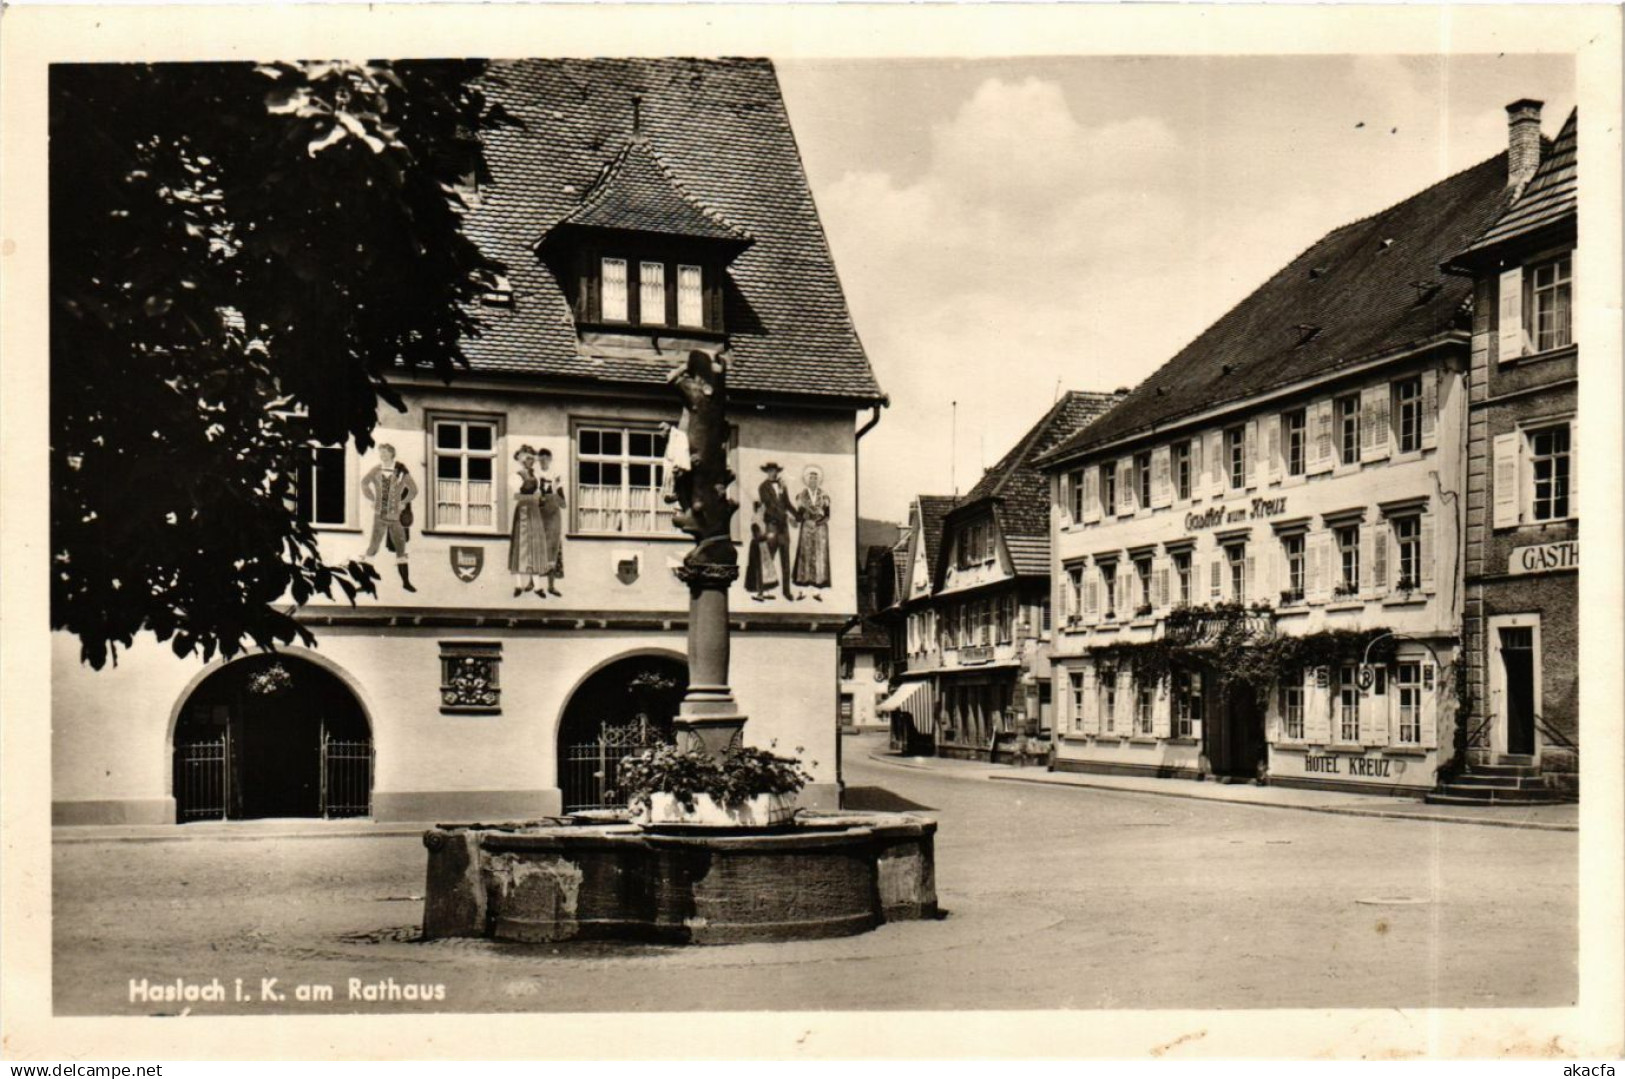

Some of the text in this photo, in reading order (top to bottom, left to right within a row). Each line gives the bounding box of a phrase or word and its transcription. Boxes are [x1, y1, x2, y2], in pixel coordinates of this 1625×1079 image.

[1250, 496, 1287, 519] Kreuz
[1304, 755, 1390, 778] HOTEL KREUZ
